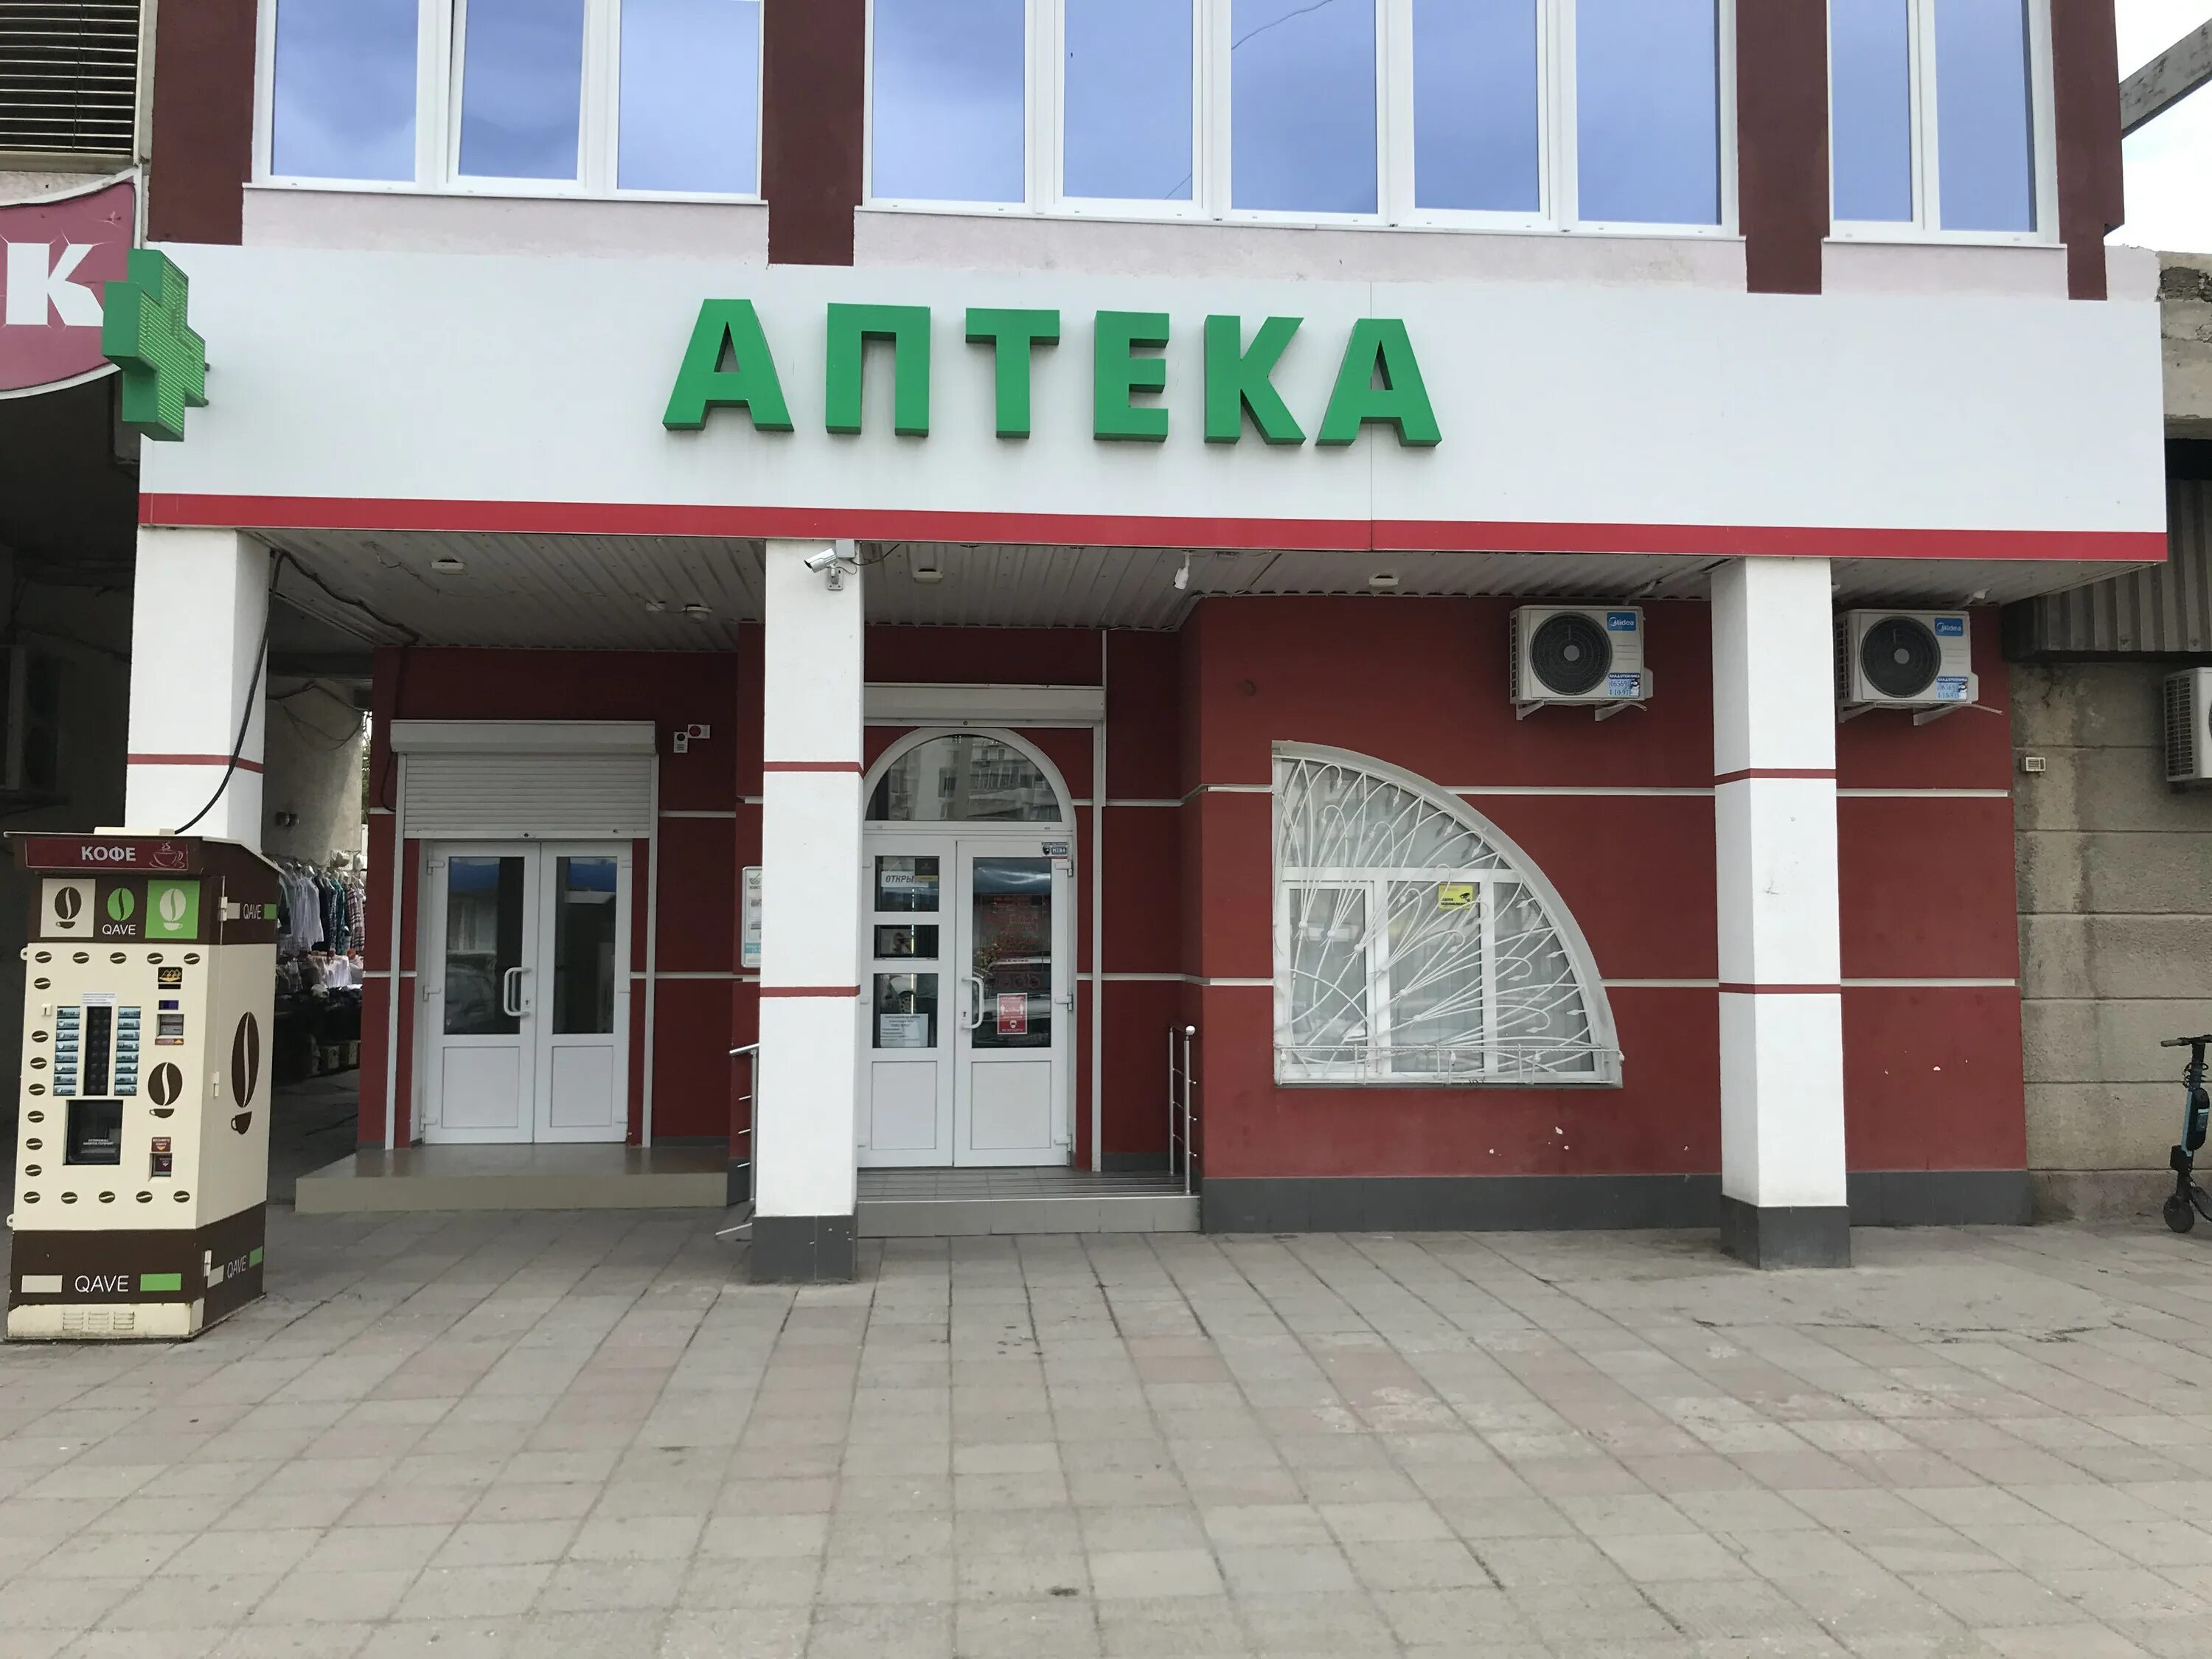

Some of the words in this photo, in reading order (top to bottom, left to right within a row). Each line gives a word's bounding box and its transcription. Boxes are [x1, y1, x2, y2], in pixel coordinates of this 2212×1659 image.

[662, 298, 1442, 447] АПТЕКА
[1609, 616, 1635, 627] Midea
[1936, 622, 1962, 632] Midea
[81, 846, 136, 862] КОФЕ
[243, 902, 262, 919] QAVE
[102, 924, 136, 936] QAVE
[227, 1255, 247, 1279] QAVE
[74, 1275, 129, 1293] QAVE
